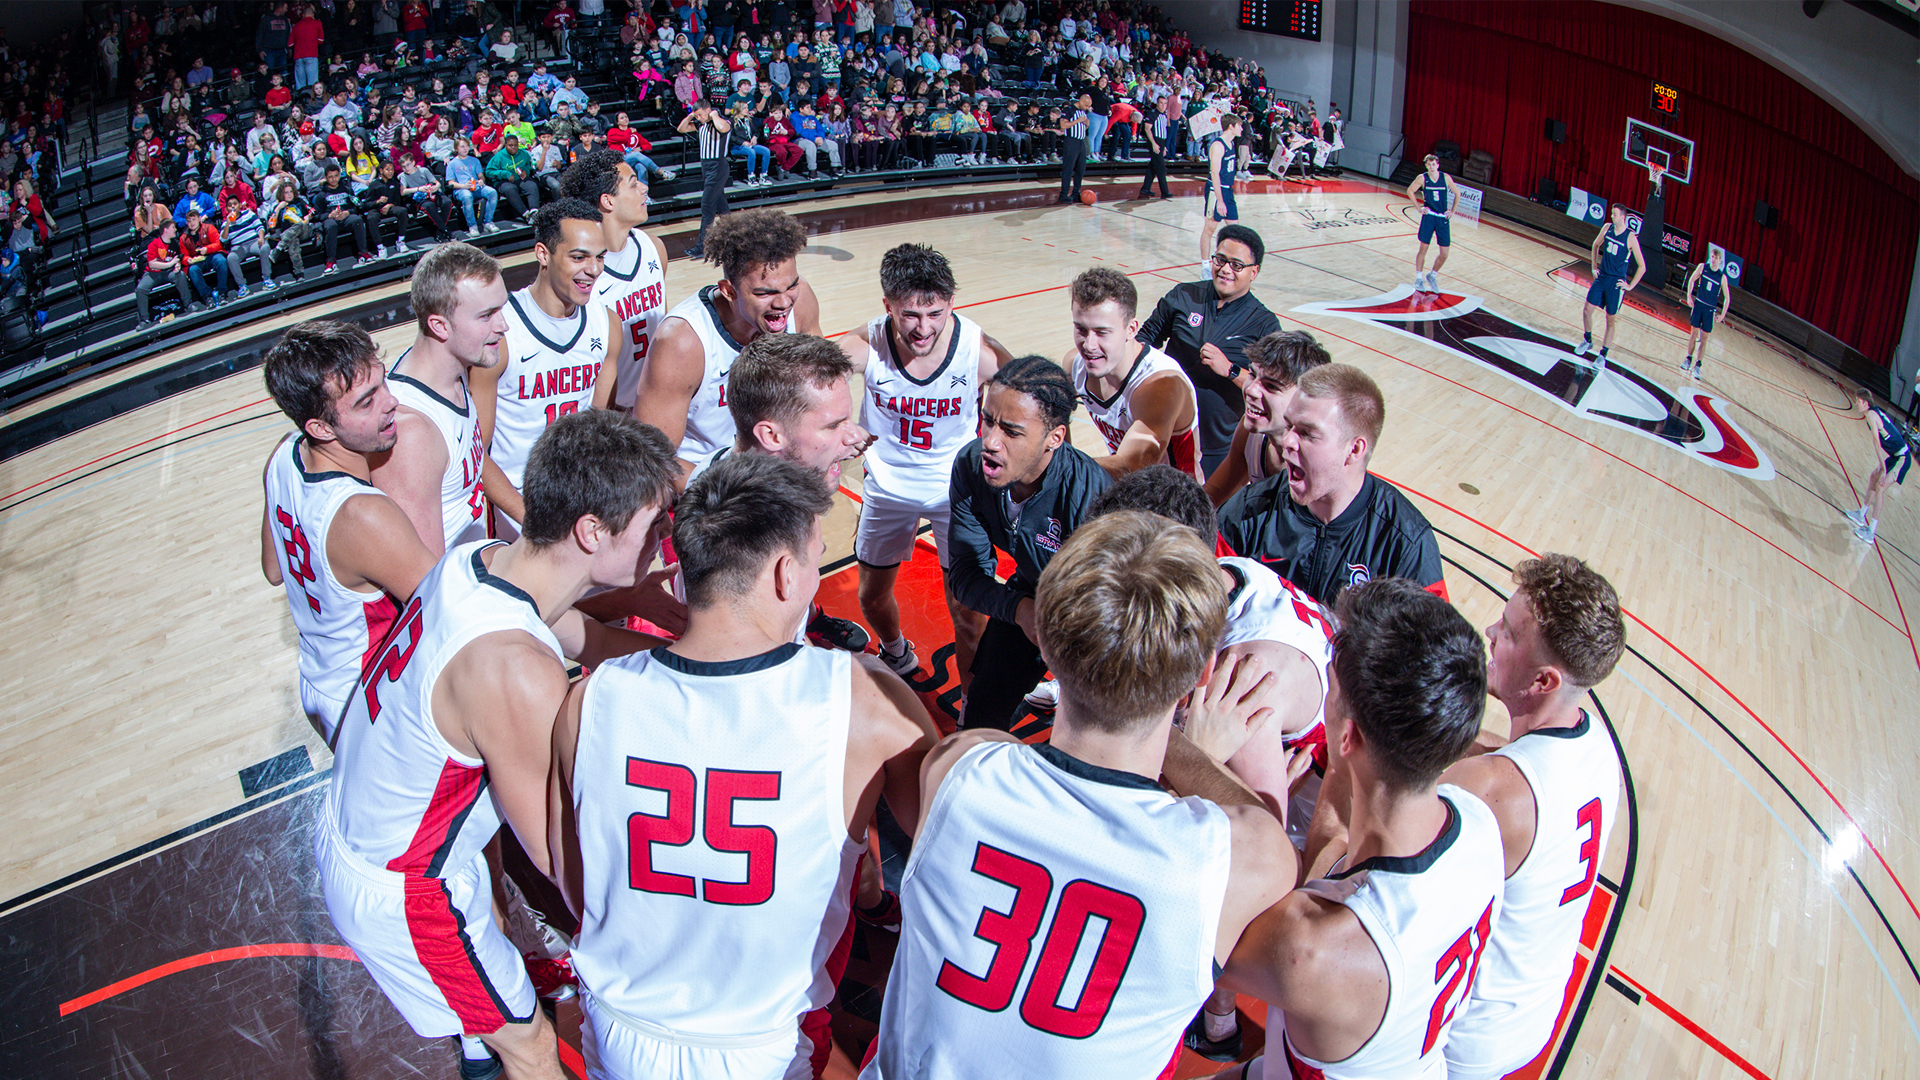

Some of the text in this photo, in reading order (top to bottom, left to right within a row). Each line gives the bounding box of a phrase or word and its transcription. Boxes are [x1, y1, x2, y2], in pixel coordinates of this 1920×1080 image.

[1654, 83, 1677, 99] 20:00
[1657, 93, 1673, 113] 30
[1432, 190, 1440, 202] 5
[1662, 231, 1690, 252] ACE
[615, 281, 662, 323] ANCERS
[631, 319, 649, 362] 5
[518, 361, 601, 400] LANCERS
[875, 392, 962, 419] LANCERS
[899, 417, 934, 451] 15
[625, 755, 782, 906] 25
[1559, 796, 1602, 907] 3
[936, 841, 1146, 1039] 30
